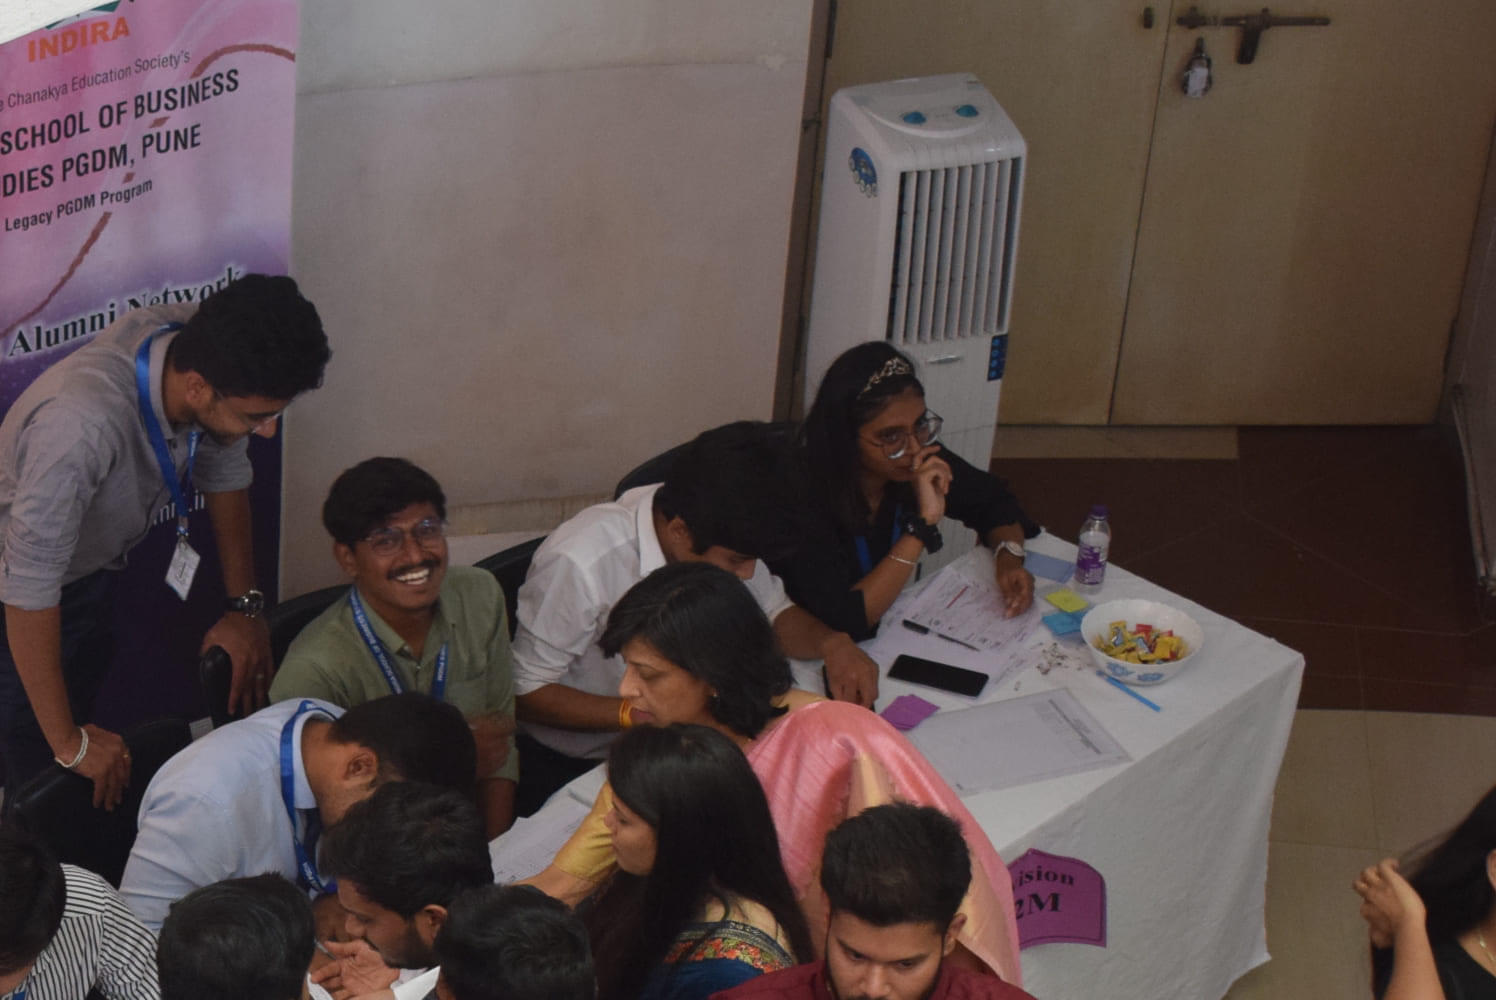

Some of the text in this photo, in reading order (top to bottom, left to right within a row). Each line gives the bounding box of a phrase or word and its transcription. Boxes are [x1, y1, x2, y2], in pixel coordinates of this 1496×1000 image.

[28, 17, 130, 62] INDIRA
[8, 80, 68, 108] Chanakya
[71, 65, 132, 92] Education
[134, 50, 191, 75] Society's
[0, 112, 90, 155] SCHOOL
[99, 100, 128, 129] OF
[134, 69, 239, 119] BUSINESS
[62, 143, 135, 182] PGDM,
[142, 124, 201, 158] PUNE
[5, 179, 153, 232] Legacy PGDM Program
[9, 303, 116, 357] Alumni
[1017, 865, 1074, 887] ision
